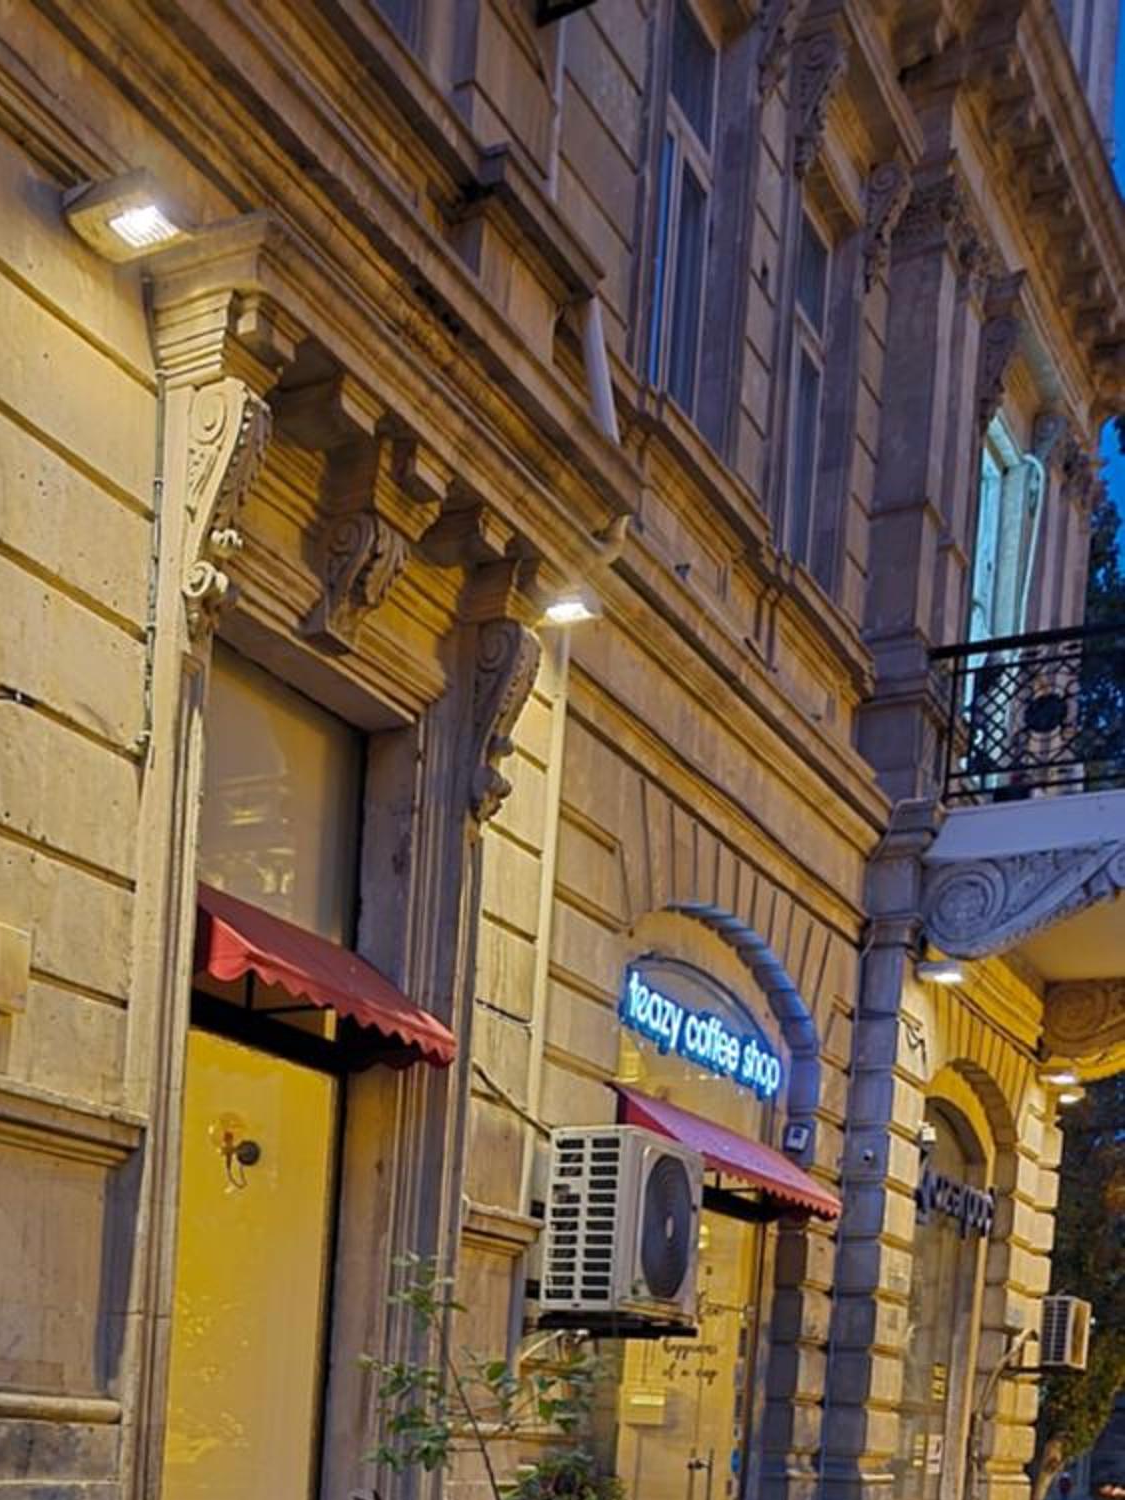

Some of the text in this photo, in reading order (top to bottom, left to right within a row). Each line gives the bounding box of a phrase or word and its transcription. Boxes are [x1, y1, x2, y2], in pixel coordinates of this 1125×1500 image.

[629, 971, 780, 1097] teazy coffee shop
